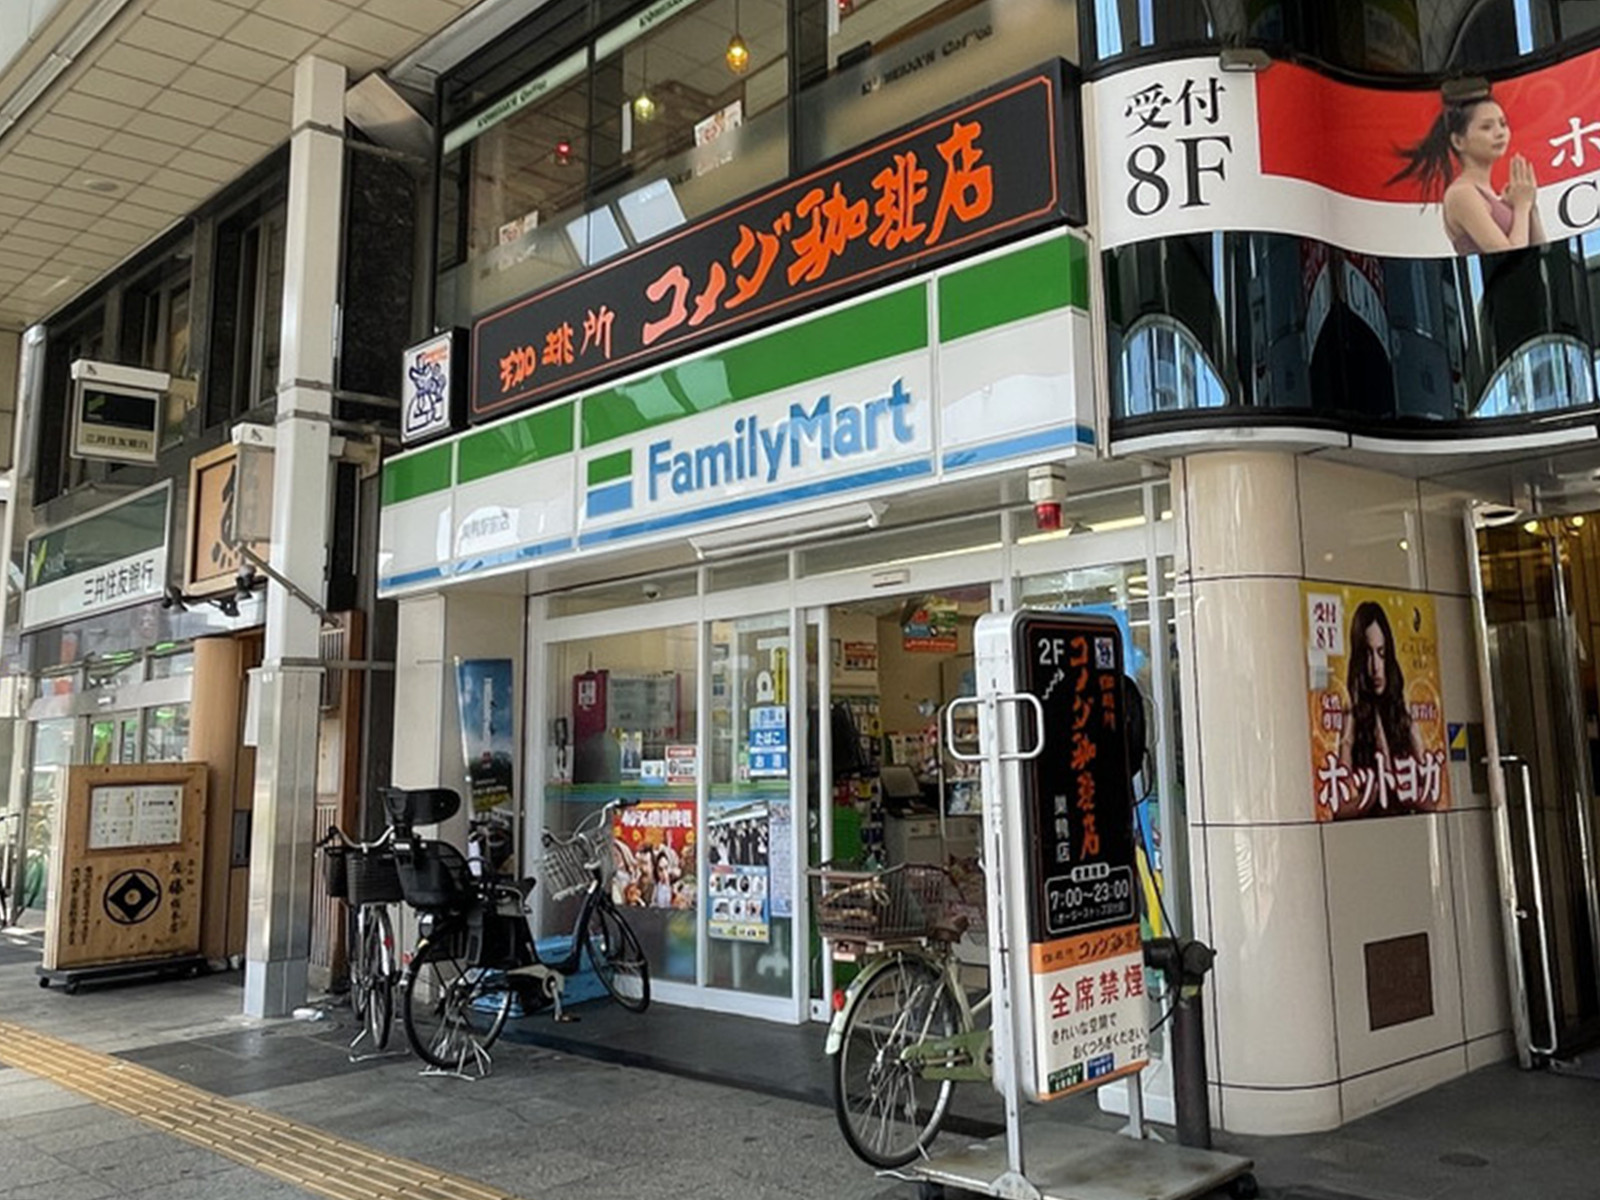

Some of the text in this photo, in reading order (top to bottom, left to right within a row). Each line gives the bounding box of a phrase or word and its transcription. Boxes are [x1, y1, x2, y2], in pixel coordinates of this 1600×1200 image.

[1125, 77, 1226, 137] 受付
[1127, 136, 1233, 216] 8F
[648, 377, 914, 501] FamilyMart
[83, 557, 154, 606] 三井住友銀行
[1038, 638, 1065, 666] 2F
[1318, 751, 1446, 813] ホットヨガ
[1050, 963, 1144, 1019] 全席禁煙
[1052, 1012, 1117, 1046] きれいな空間で
